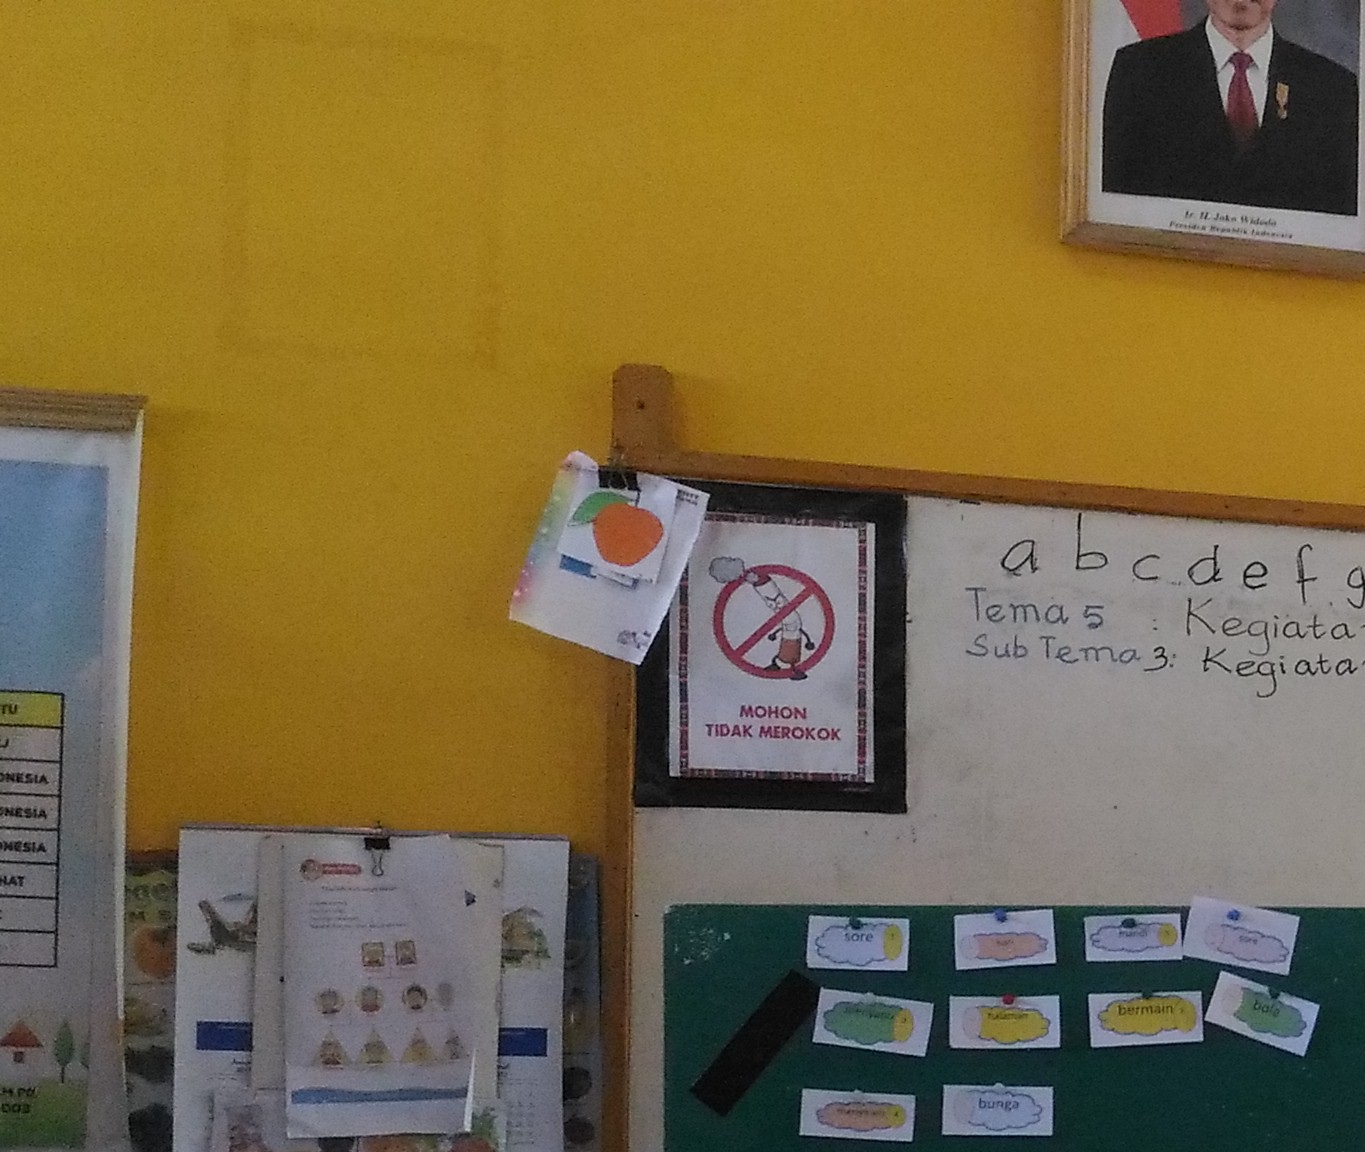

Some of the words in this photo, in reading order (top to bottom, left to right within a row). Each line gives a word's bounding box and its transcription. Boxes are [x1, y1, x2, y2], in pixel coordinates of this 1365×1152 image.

[965, 586, 1070, 626] Tema
[1081, 604, 1106, 630] 5
[965, 633, 1031, 660] Sub
[1038, 634, 1142, 666] Tema
[739, 705, 808, 720] MOHON
[704, 723, 754, 739] TIDAK
[758, 724, 842, 742] MEROKOK
[844, 931, 874, 943] sore
[1117, 1003, 1174, 1018] bermain
[978, 1098, 1020, 1112] bunga
